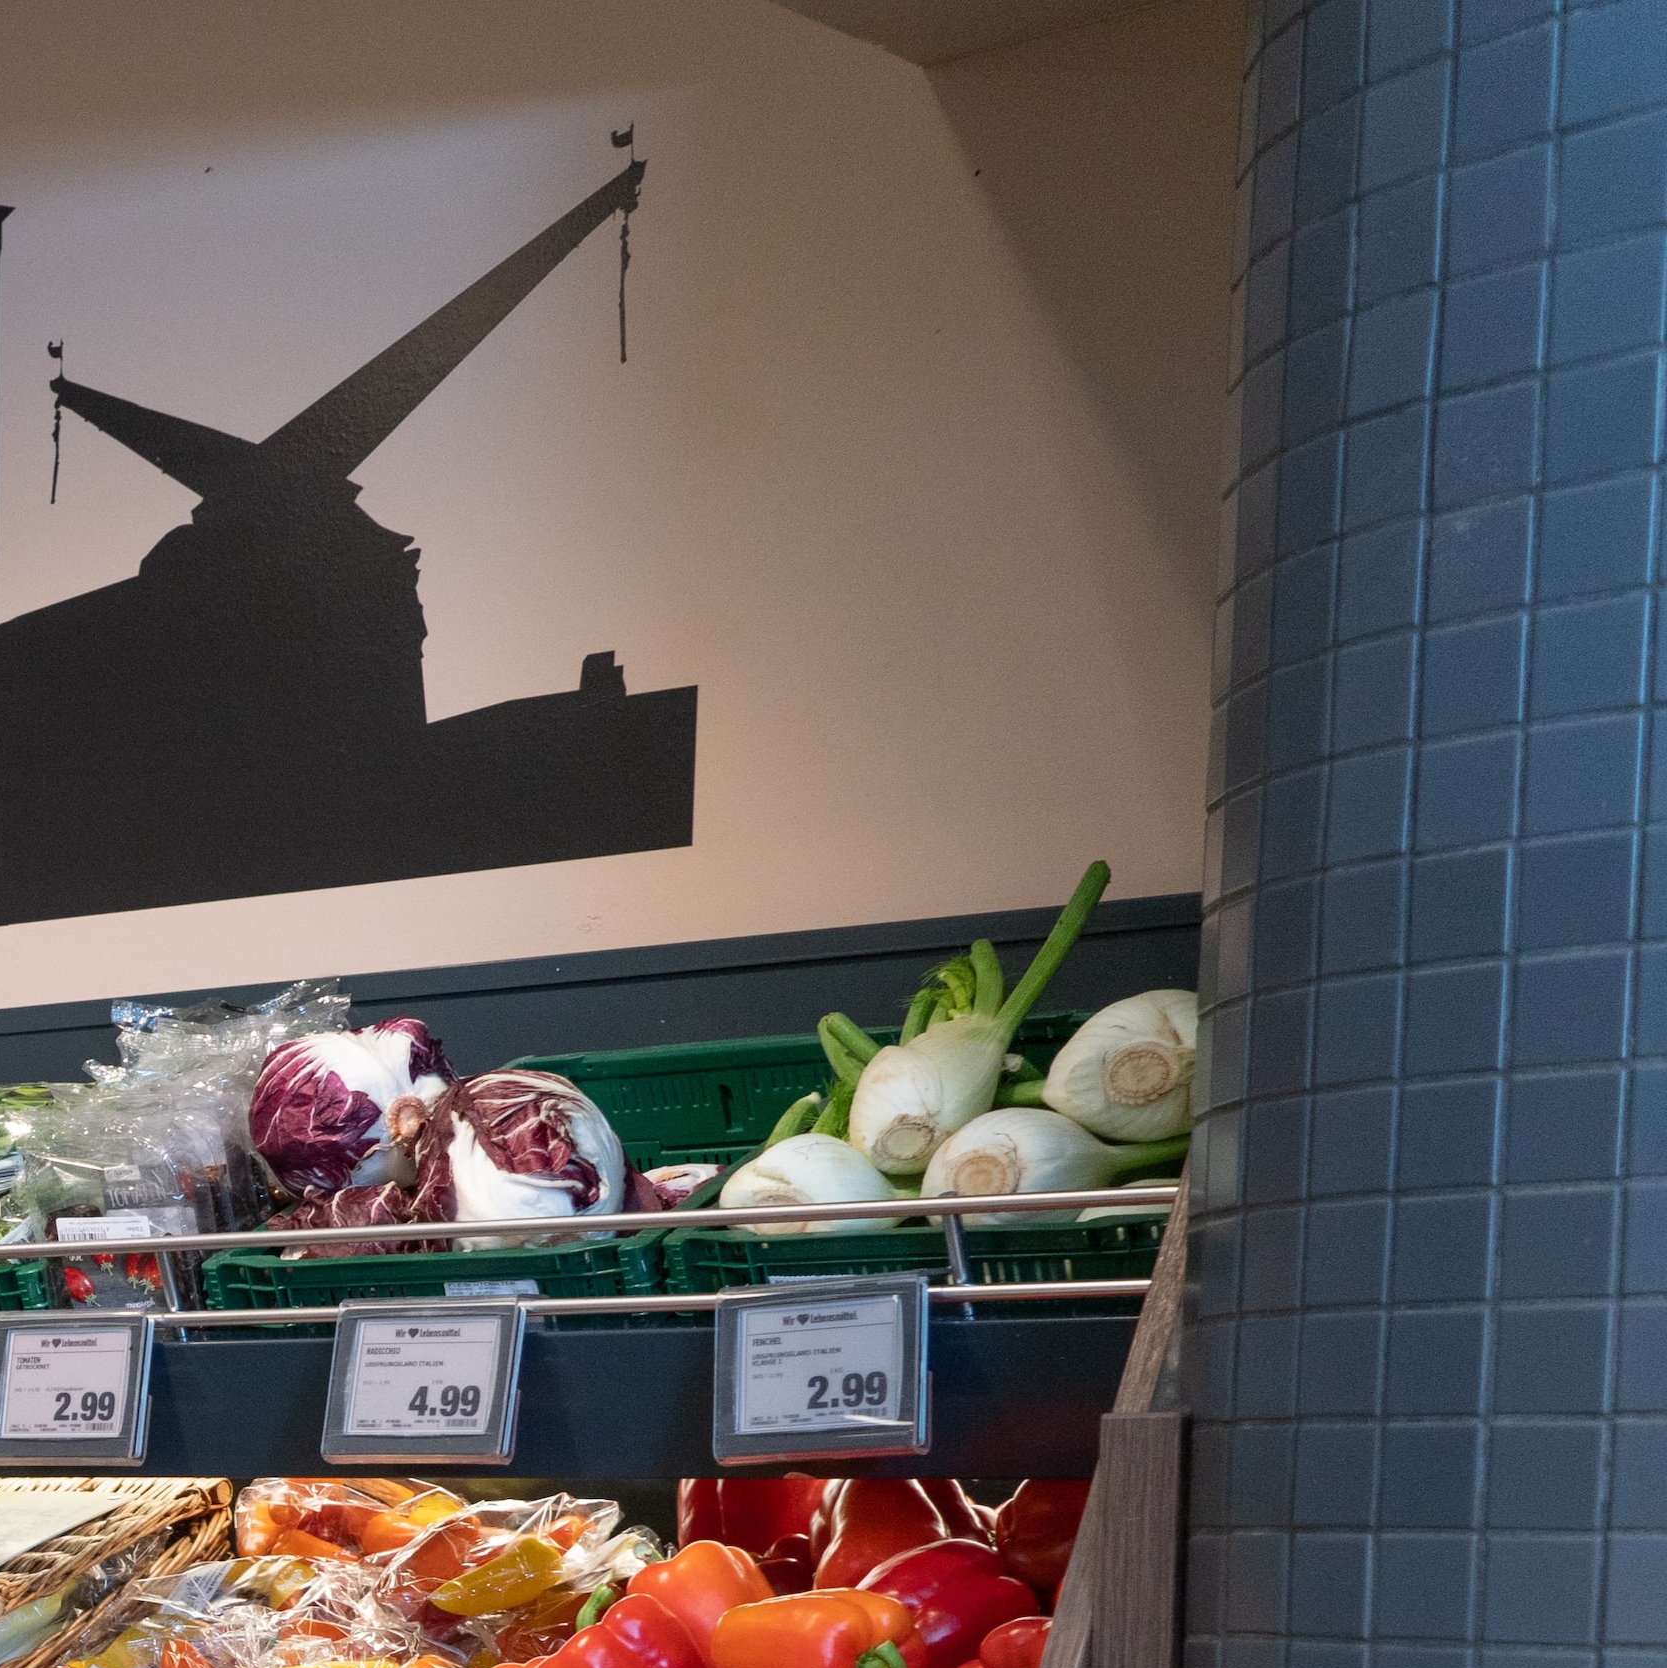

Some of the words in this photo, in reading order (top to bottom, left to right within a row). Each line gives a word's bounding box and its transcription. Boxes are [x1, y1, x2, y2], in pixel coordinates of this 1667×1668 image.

[366, 1347, 401, 1355] RADICCHIO
[752, 1336, 782, 1346] FENCHEL
[16, 1356, 41, 1364] TOMATEN
[408, 1384, 481, 1417] 4.99
[806, 1370, 888, 1411] 2.99
[53, 1391, 116, 1422] 2.99
